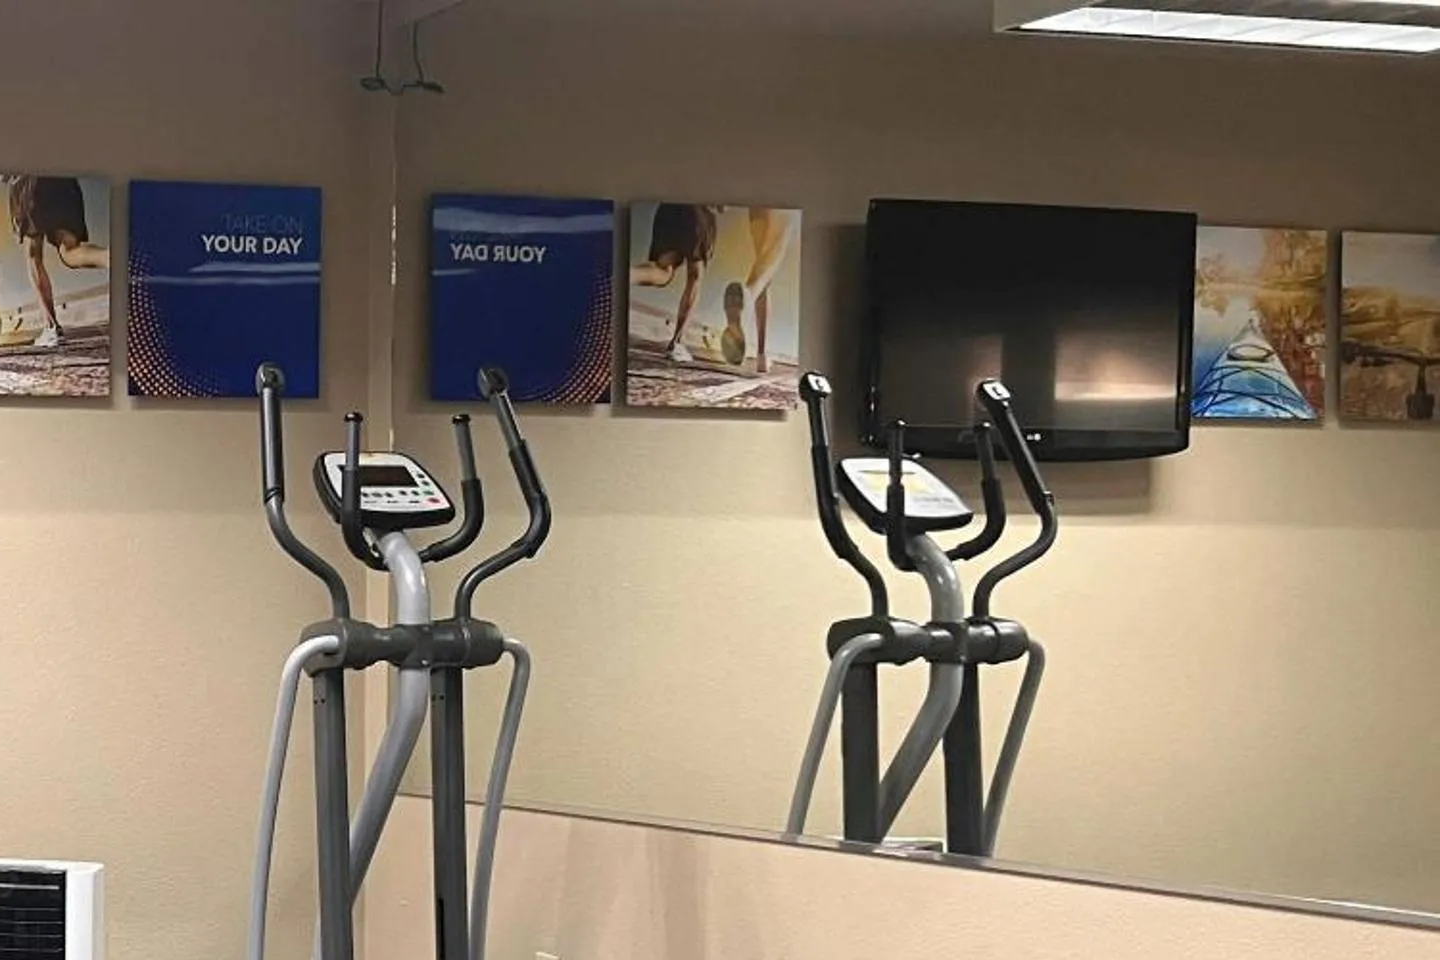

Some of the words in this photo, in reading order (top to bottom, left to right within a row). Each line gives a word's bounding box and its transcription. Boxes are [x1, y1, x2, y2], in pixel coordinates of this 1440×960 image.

[221, 213, 267, 234] TAKE
[275, 213, 303, 235] ON
[201, 234, 258, 254] YOUR
[262, 236, 303, 256] DAY
